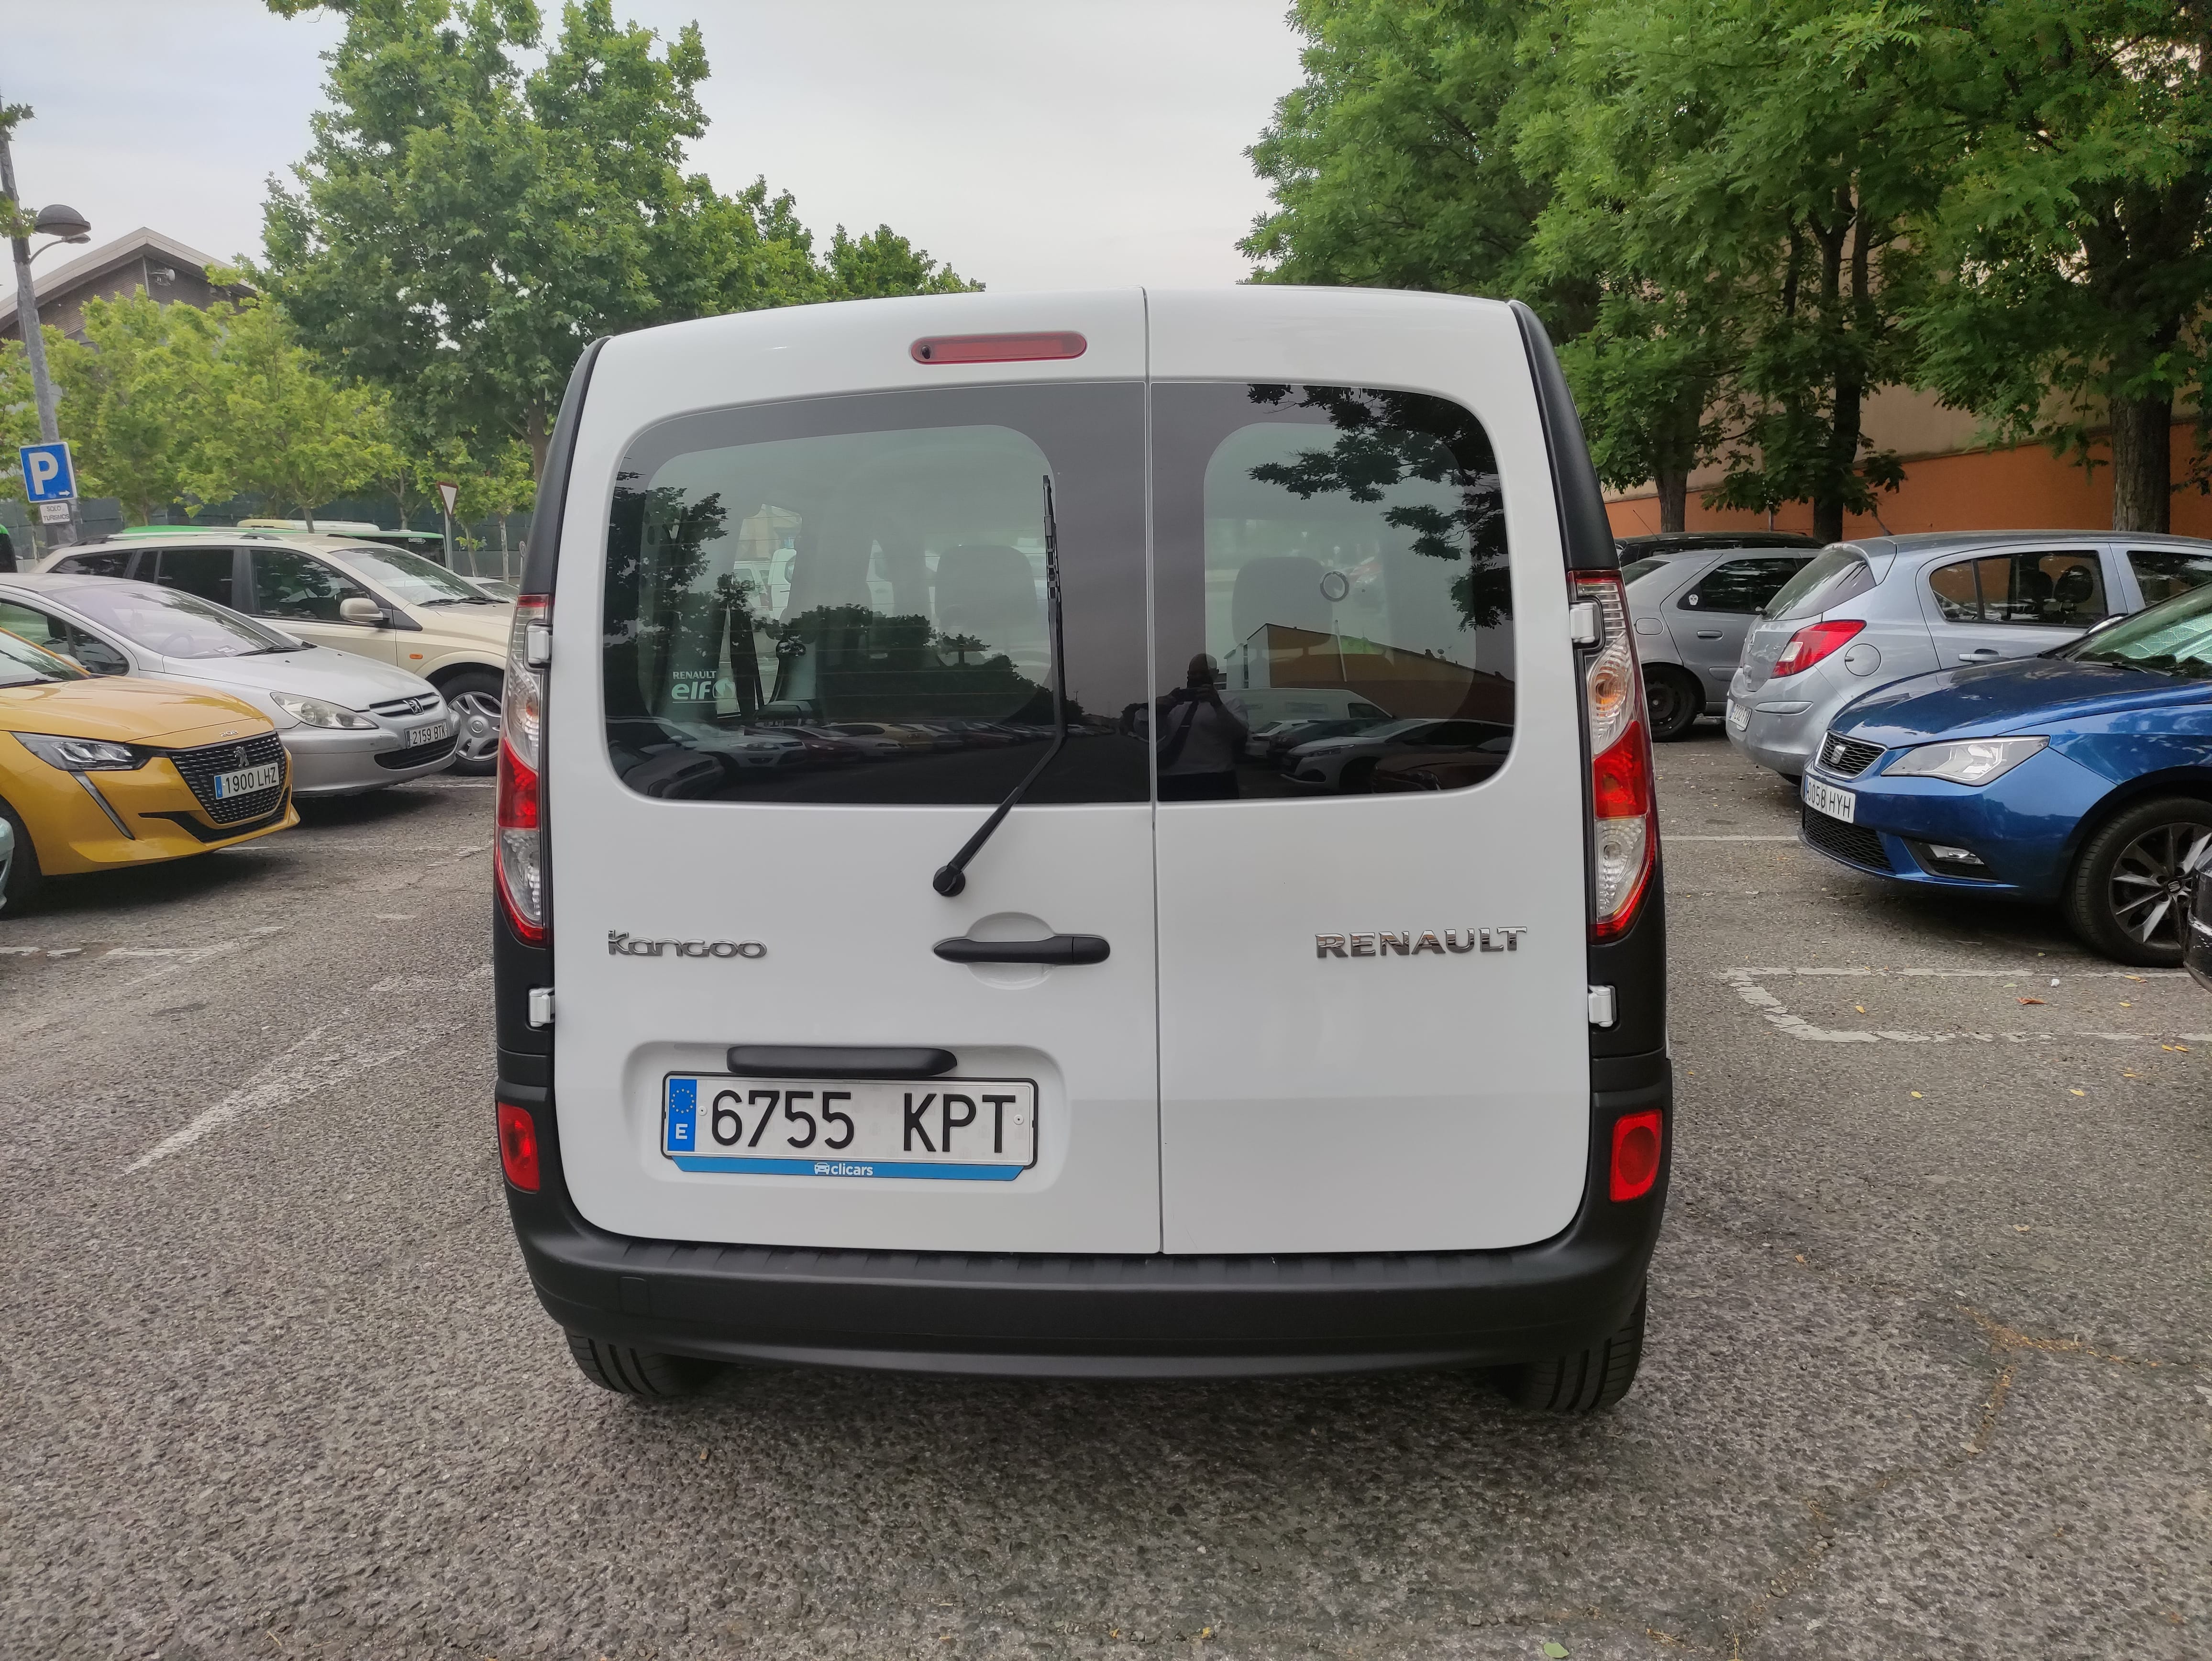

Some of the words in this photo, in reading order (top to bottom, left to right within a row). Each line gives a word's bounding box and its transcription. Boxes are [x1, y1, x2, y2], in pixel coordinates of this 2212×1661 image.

[29, 452, 58, 495] P
[673, 671, 717, 679] RENAULT
[672, 681, 711, 699] elf
[412, 728, 431, 744] 2159
[433, 724, 446, 740] BTK
[226, 772, 254, 794] 1900
[257, 766, 276, 787] LHZ
[1808, 782, 1826, 808] 0058
[1829, 791, 1851, 818] HYH
[1315, 926, 1527, 958] RENAULT
[675, 1123, 688, 1140] E
[711, 1089, 854, 1149] 6755
[904, 1093, 1016, 1153] KPT
[831, 1163, 873, 1176] clicars
